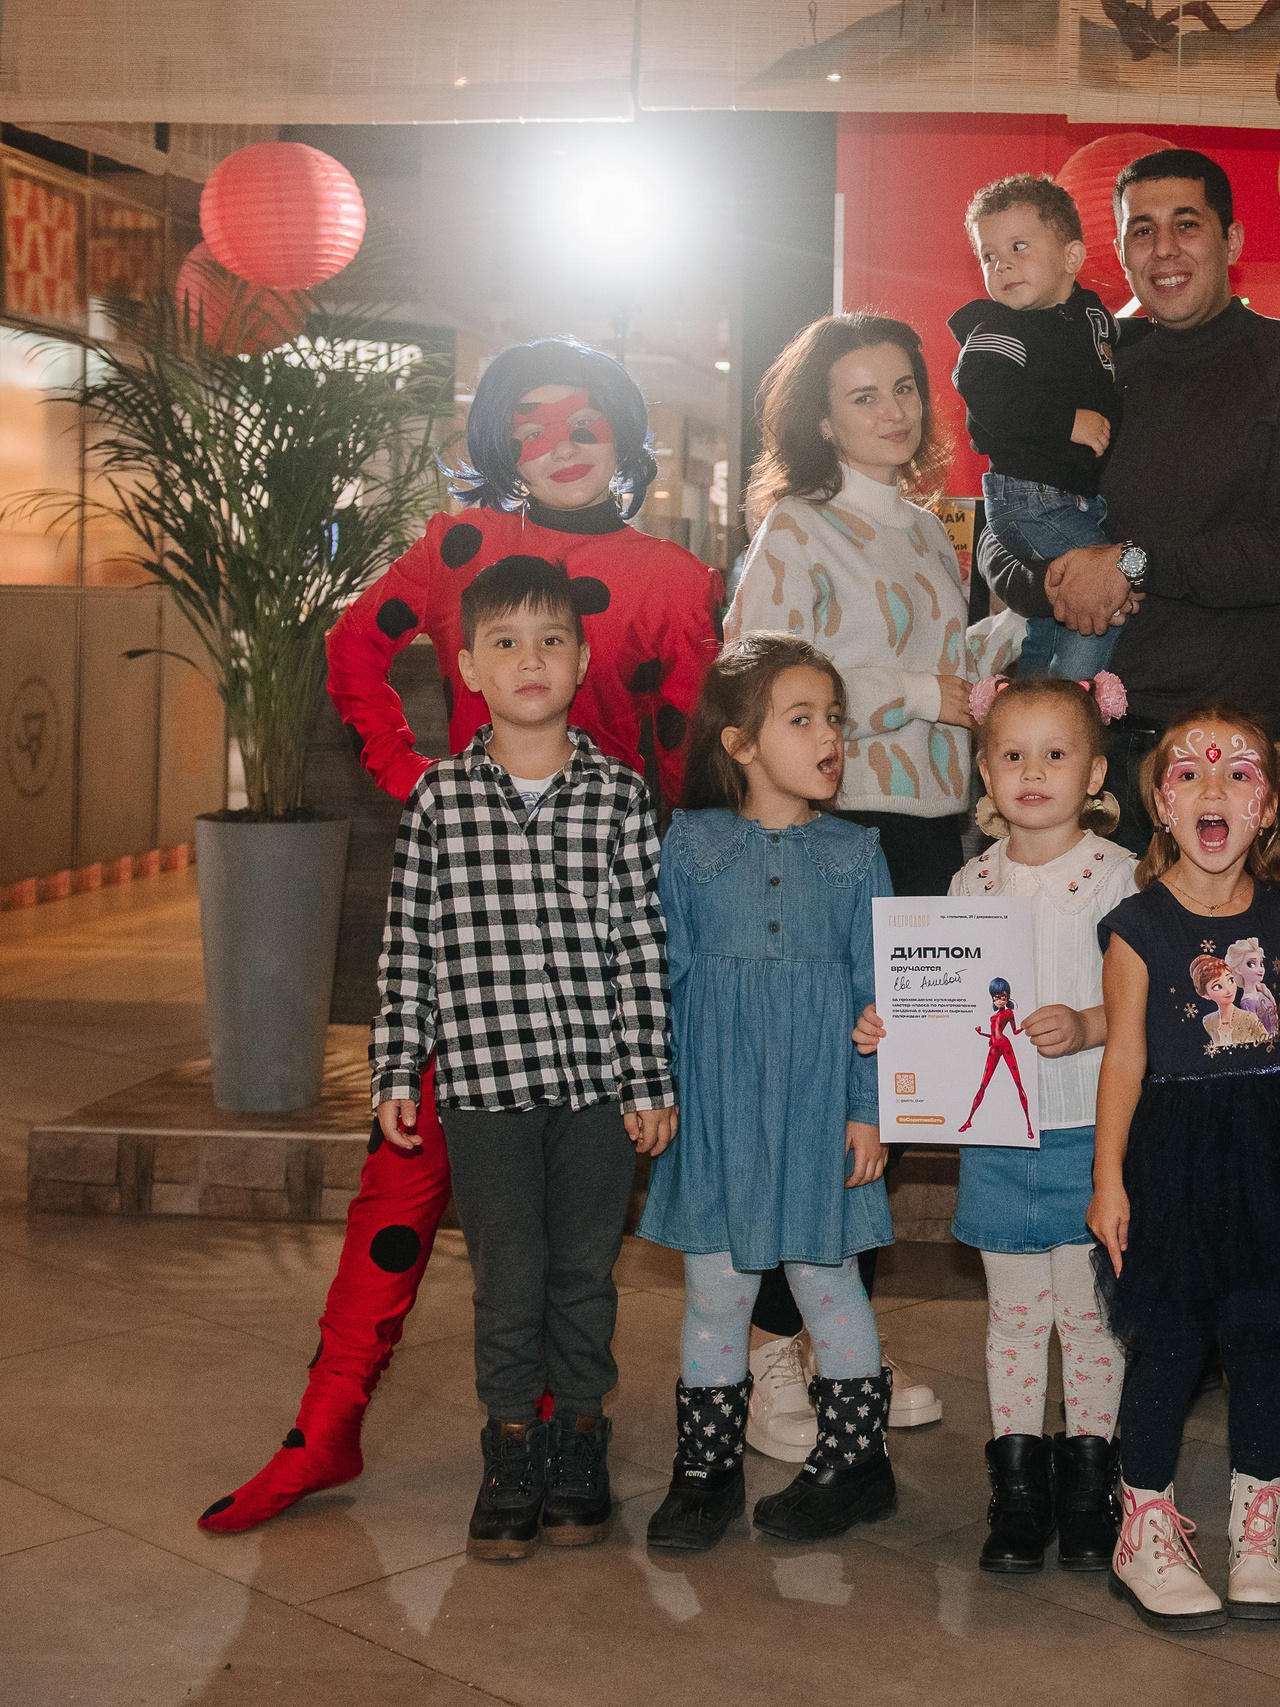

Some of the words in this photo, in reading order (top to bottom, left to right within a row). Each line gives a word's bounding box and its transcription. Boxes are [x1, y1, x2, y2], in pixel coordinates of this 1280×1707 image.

[890, 946, 982, 960] ДИПЛОМ
[890, 965, 942, 974] вручается
[685, 1470, 708, 1479] reima
